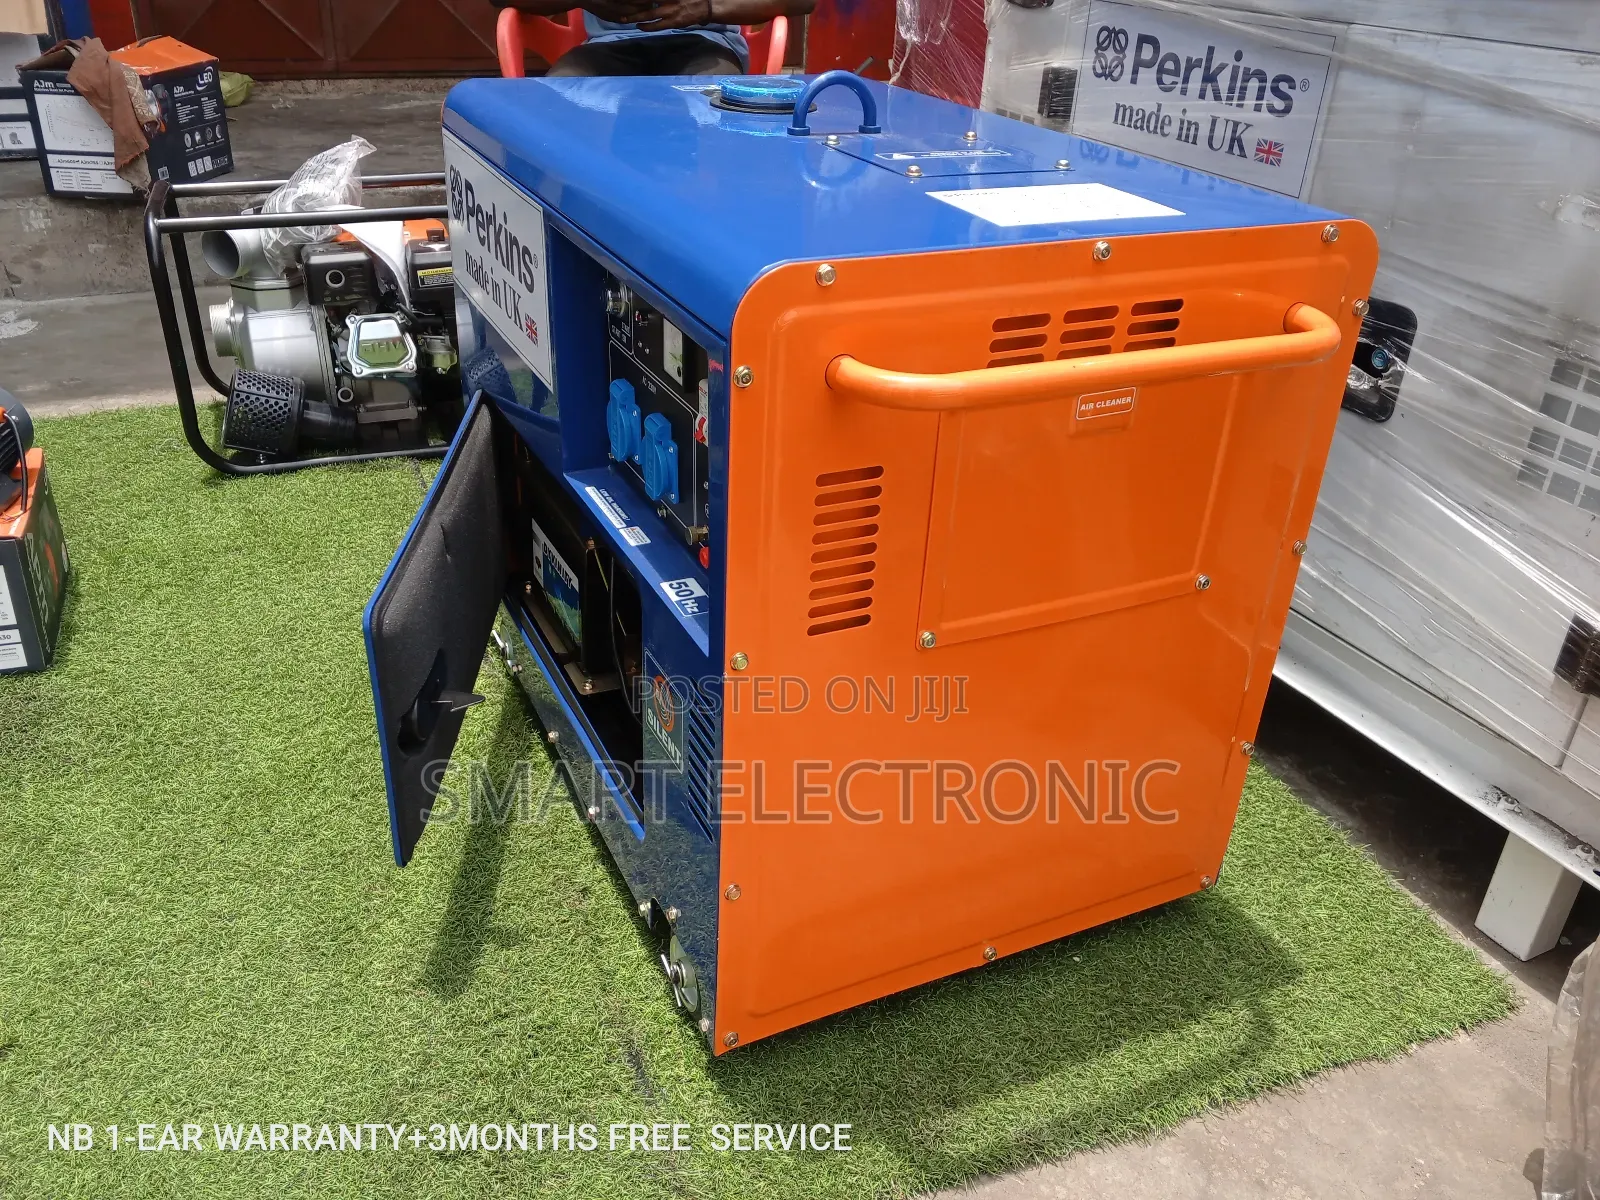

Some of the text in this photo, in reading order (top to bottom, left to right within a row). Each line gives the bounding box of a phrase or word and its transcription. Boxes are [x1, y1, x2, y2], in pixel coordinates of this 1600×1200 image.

[198, 72, 212, 84] LEO
[1112, 102, 1253, 158] made in UK
[465, 249, 524, 332] made in UK
[1080, 396, 1132, 411] AIR CLEANER
[647, 708, 681, 764] SILENT
